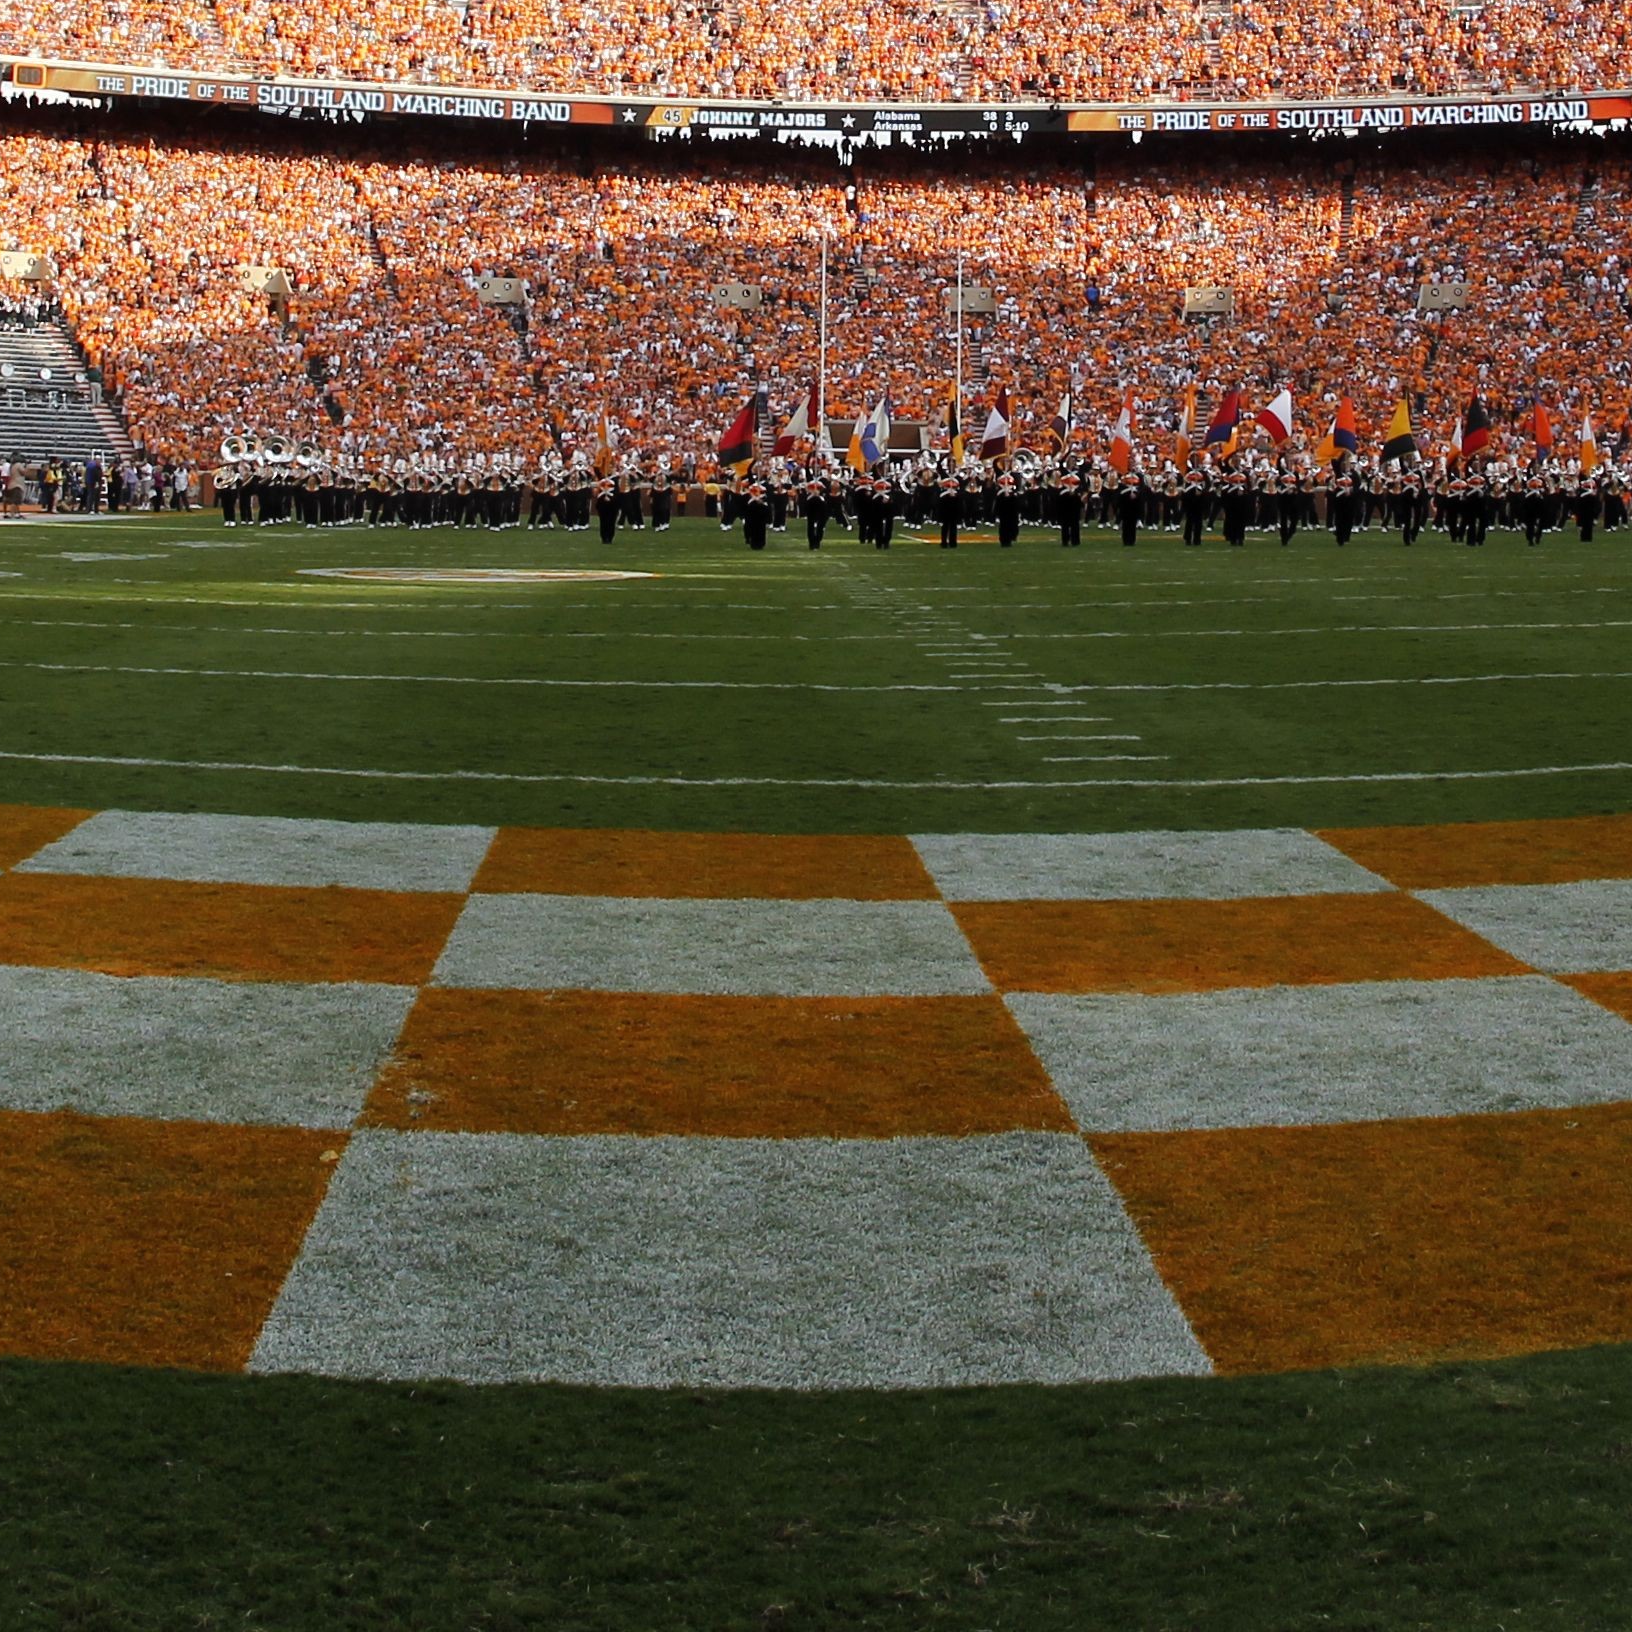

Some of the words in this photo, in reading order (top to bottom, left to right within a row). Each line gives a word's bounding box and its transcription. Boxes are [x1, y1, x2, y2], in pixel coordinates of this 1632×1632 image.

[96, 76, 125, 92] THE
[131, 76, 191, 98] PRIDE
[197, 83, 216, 98] OF
[220, 84, 250, 100] THE
[256, 85, 385, 111] SOUTHLAND
[392, 93, 505, 118] MARCHING
[511, 100, 571, 122] BAND
[664, 109, 681, 123] 45
[689, 111, 755, 125] JOHNNY
[759, 112, 826, 127] MAJORS
[873, 111, 921, 121] Alabama
[982, 111, 998, 121] 38
[1005, 111, 1014, 121] 3
[1118, 115, 1146, 129] THE
[1152, 111, 1211, 130] PRIDE
[1217, 113, 1236, 128] OF
[1240, 112, 1269, 127] THE
[1276, 107, 1404, 129] SOUTHLAND
[1411, 103, 1523, 125] MARCHING
[1529, 100, 1589, 121] BAND
[873, 121, 923, 131] Arkansas
[989, 121, 998, 131] 0
[1004, 121, 1029, 131] 5:10
